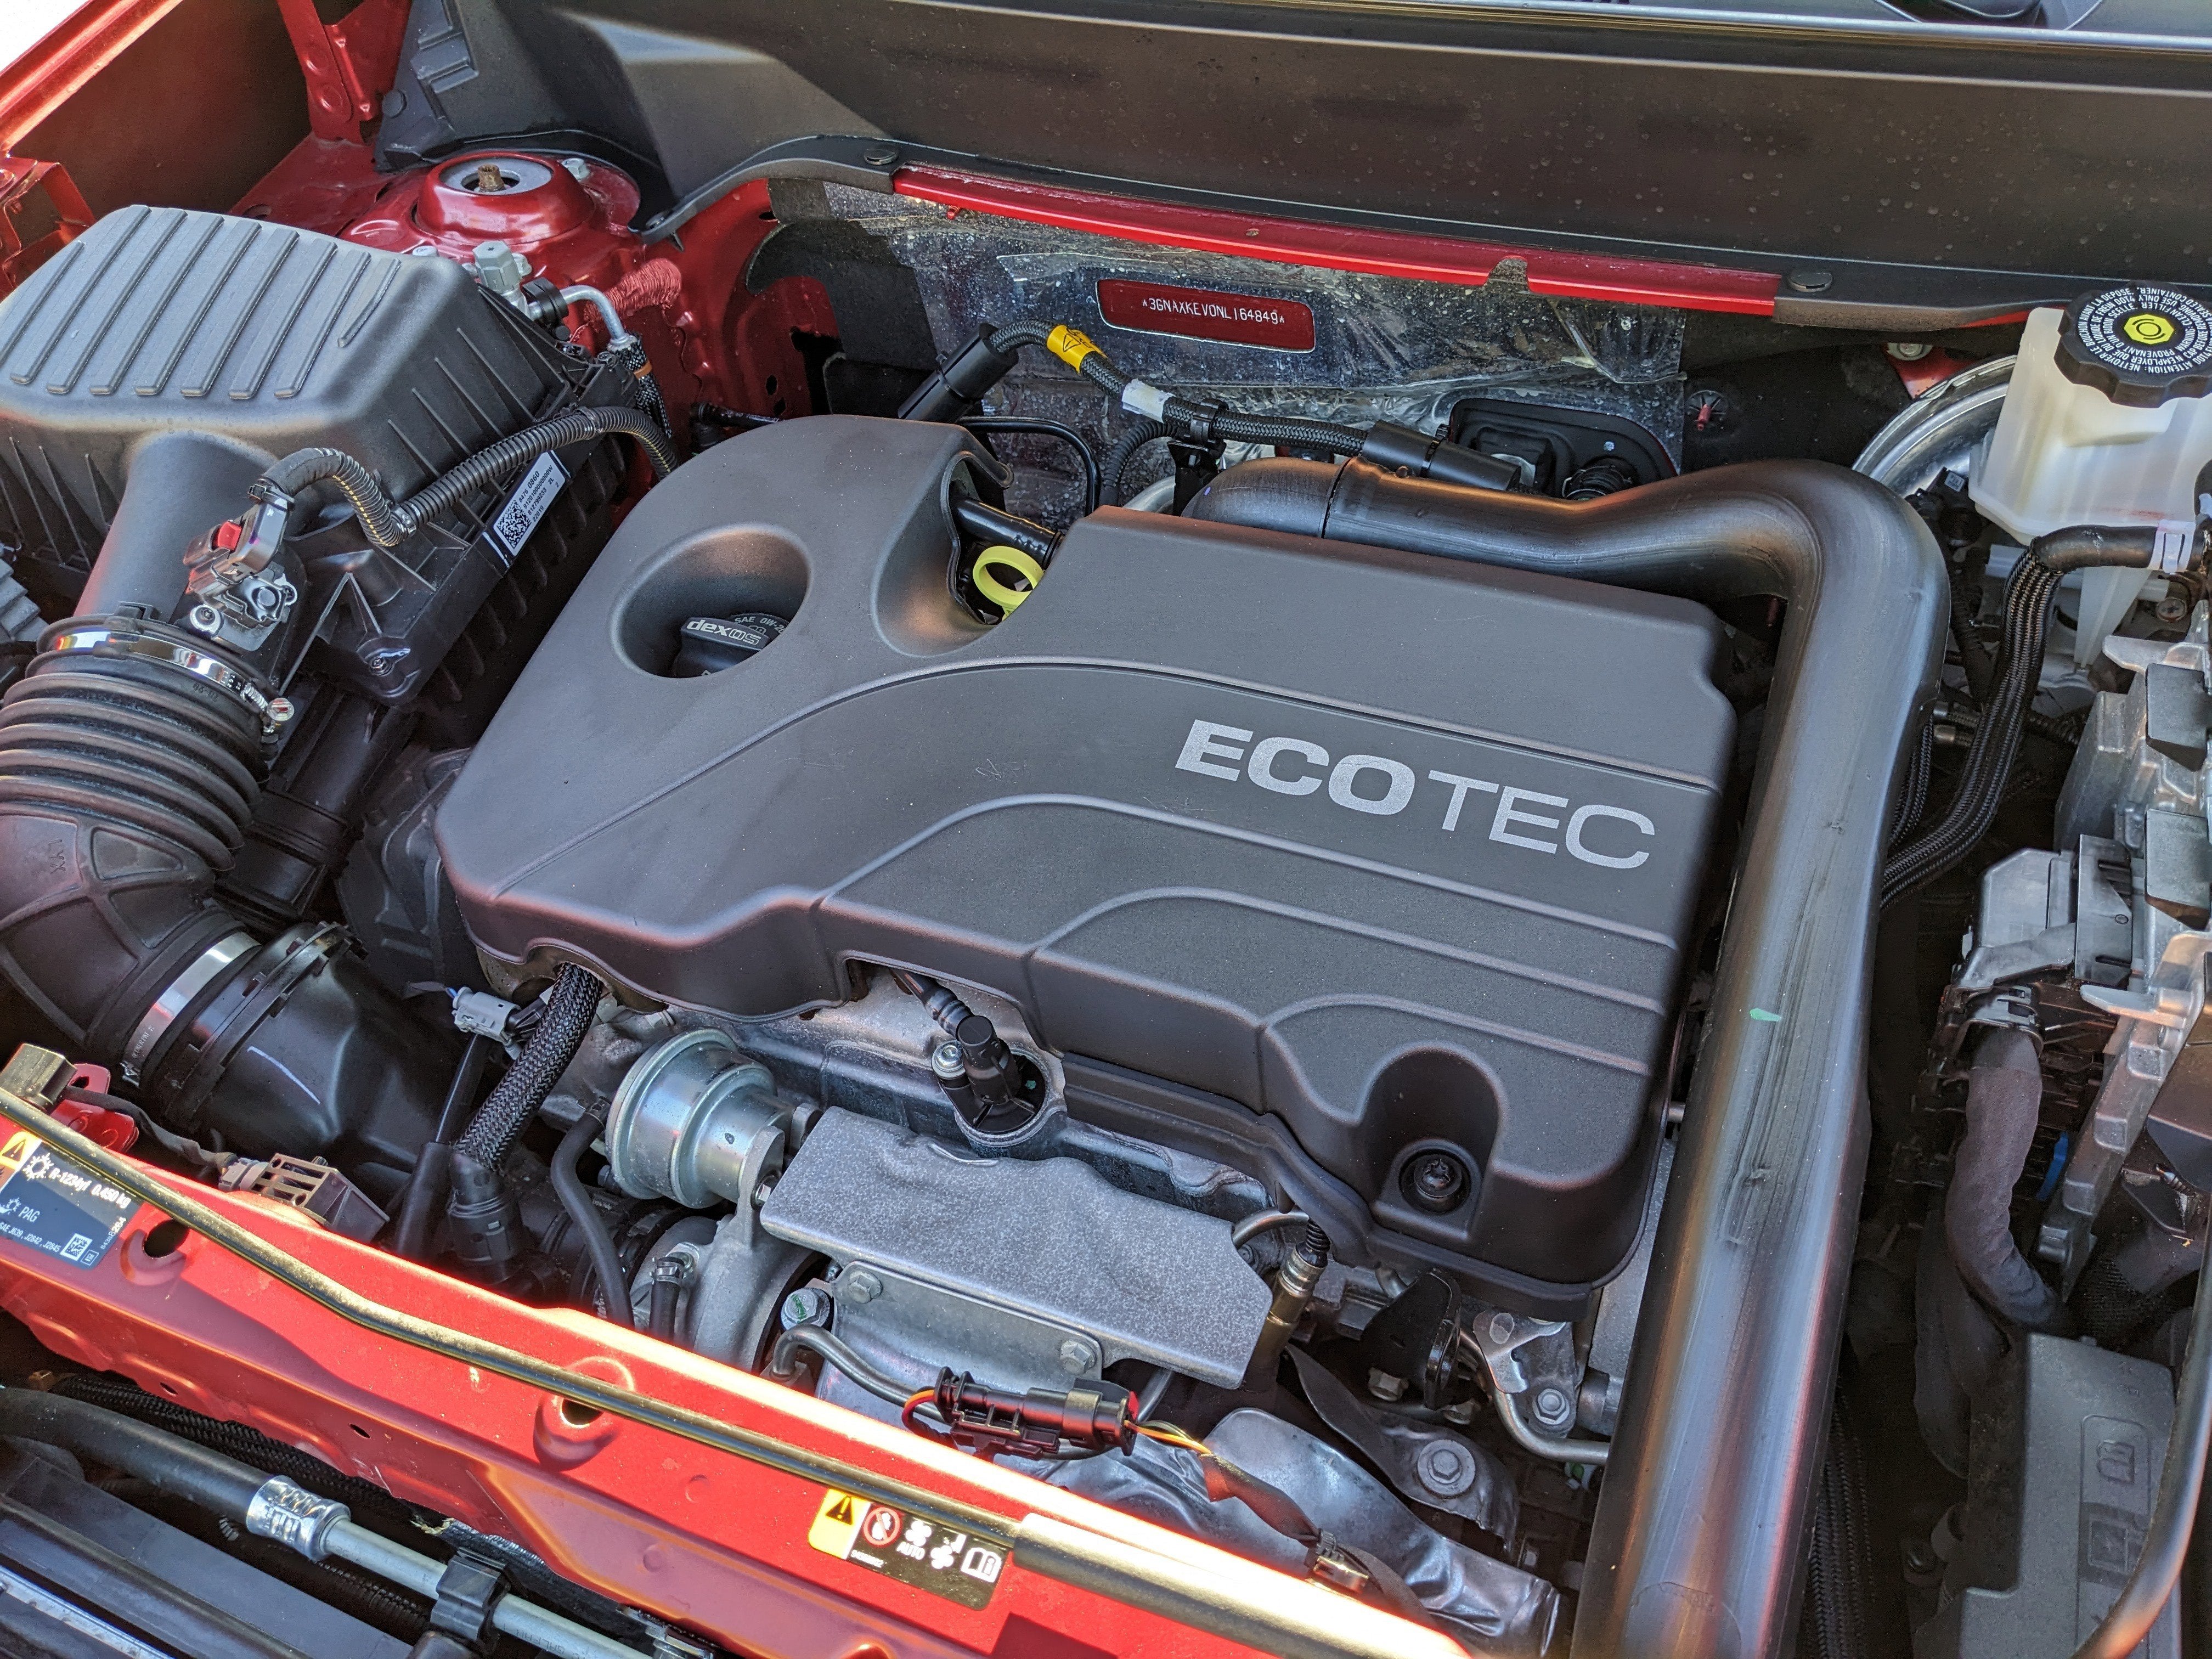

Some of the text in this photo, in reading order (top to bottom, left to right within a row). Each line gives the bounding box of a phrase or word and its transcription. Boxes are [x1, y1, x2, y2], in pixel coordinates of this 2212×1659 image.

[2091, 298, 2104, 307] LA
[2101, 288, 2134, 301] DEPOSE.
[2114, 296, 2135, 306] DOT4
[2136, 287, 2187, 302] CONTAINER.
[2138, 294, 2159, 302] ONLY
[2161, 297, 2177, 307] USE
[2079, 304, 2095, 321] AVANT
[2095, 302, 2115, 316] FREIN
[2108, 303, 2138, 318] SCELLE.
[2178, 303, 2207, 330] REMOVING.
[2185, 299, 2212, 318] SEALED
[2078, 321, 2095, 347] BOUCHON
[2090, 323, 2106, 343] LIQUIDE
[2103, 318, 2114, 334] BIDON
[2141, 302, 2196, 352] WARNING: CLEAN FILLER
[2101, 343, 2114, 352] DU
[2192, 330, 2208, 351] BEFORE
[2090, 346, 2102, 354] LE
[2112, 349, 2130, 360] QUE
[2123, 346, 2175, 358] PROVENANT
[2183, 347, 2198, 358] CAP
[2099, 352, 2140, 371] NETTOYER
[2131, 355, 2183, 365] N'EMPLOYER
[518, 471, 540, 503] 8476 0860
[532, 505, 544, 522] 22019
[687, 619, 761, 645] dexos
[1175, 719, 1655, 870] ECOTEC
[91, 1184, 120, 1202] 0.450
[116, 1193, 132, 1209] kg
[18, 1206, 40, 1222] PAG
[43, 1241, 61, 1252] J2845
[896, 1542, 926, 1560] AUTO
